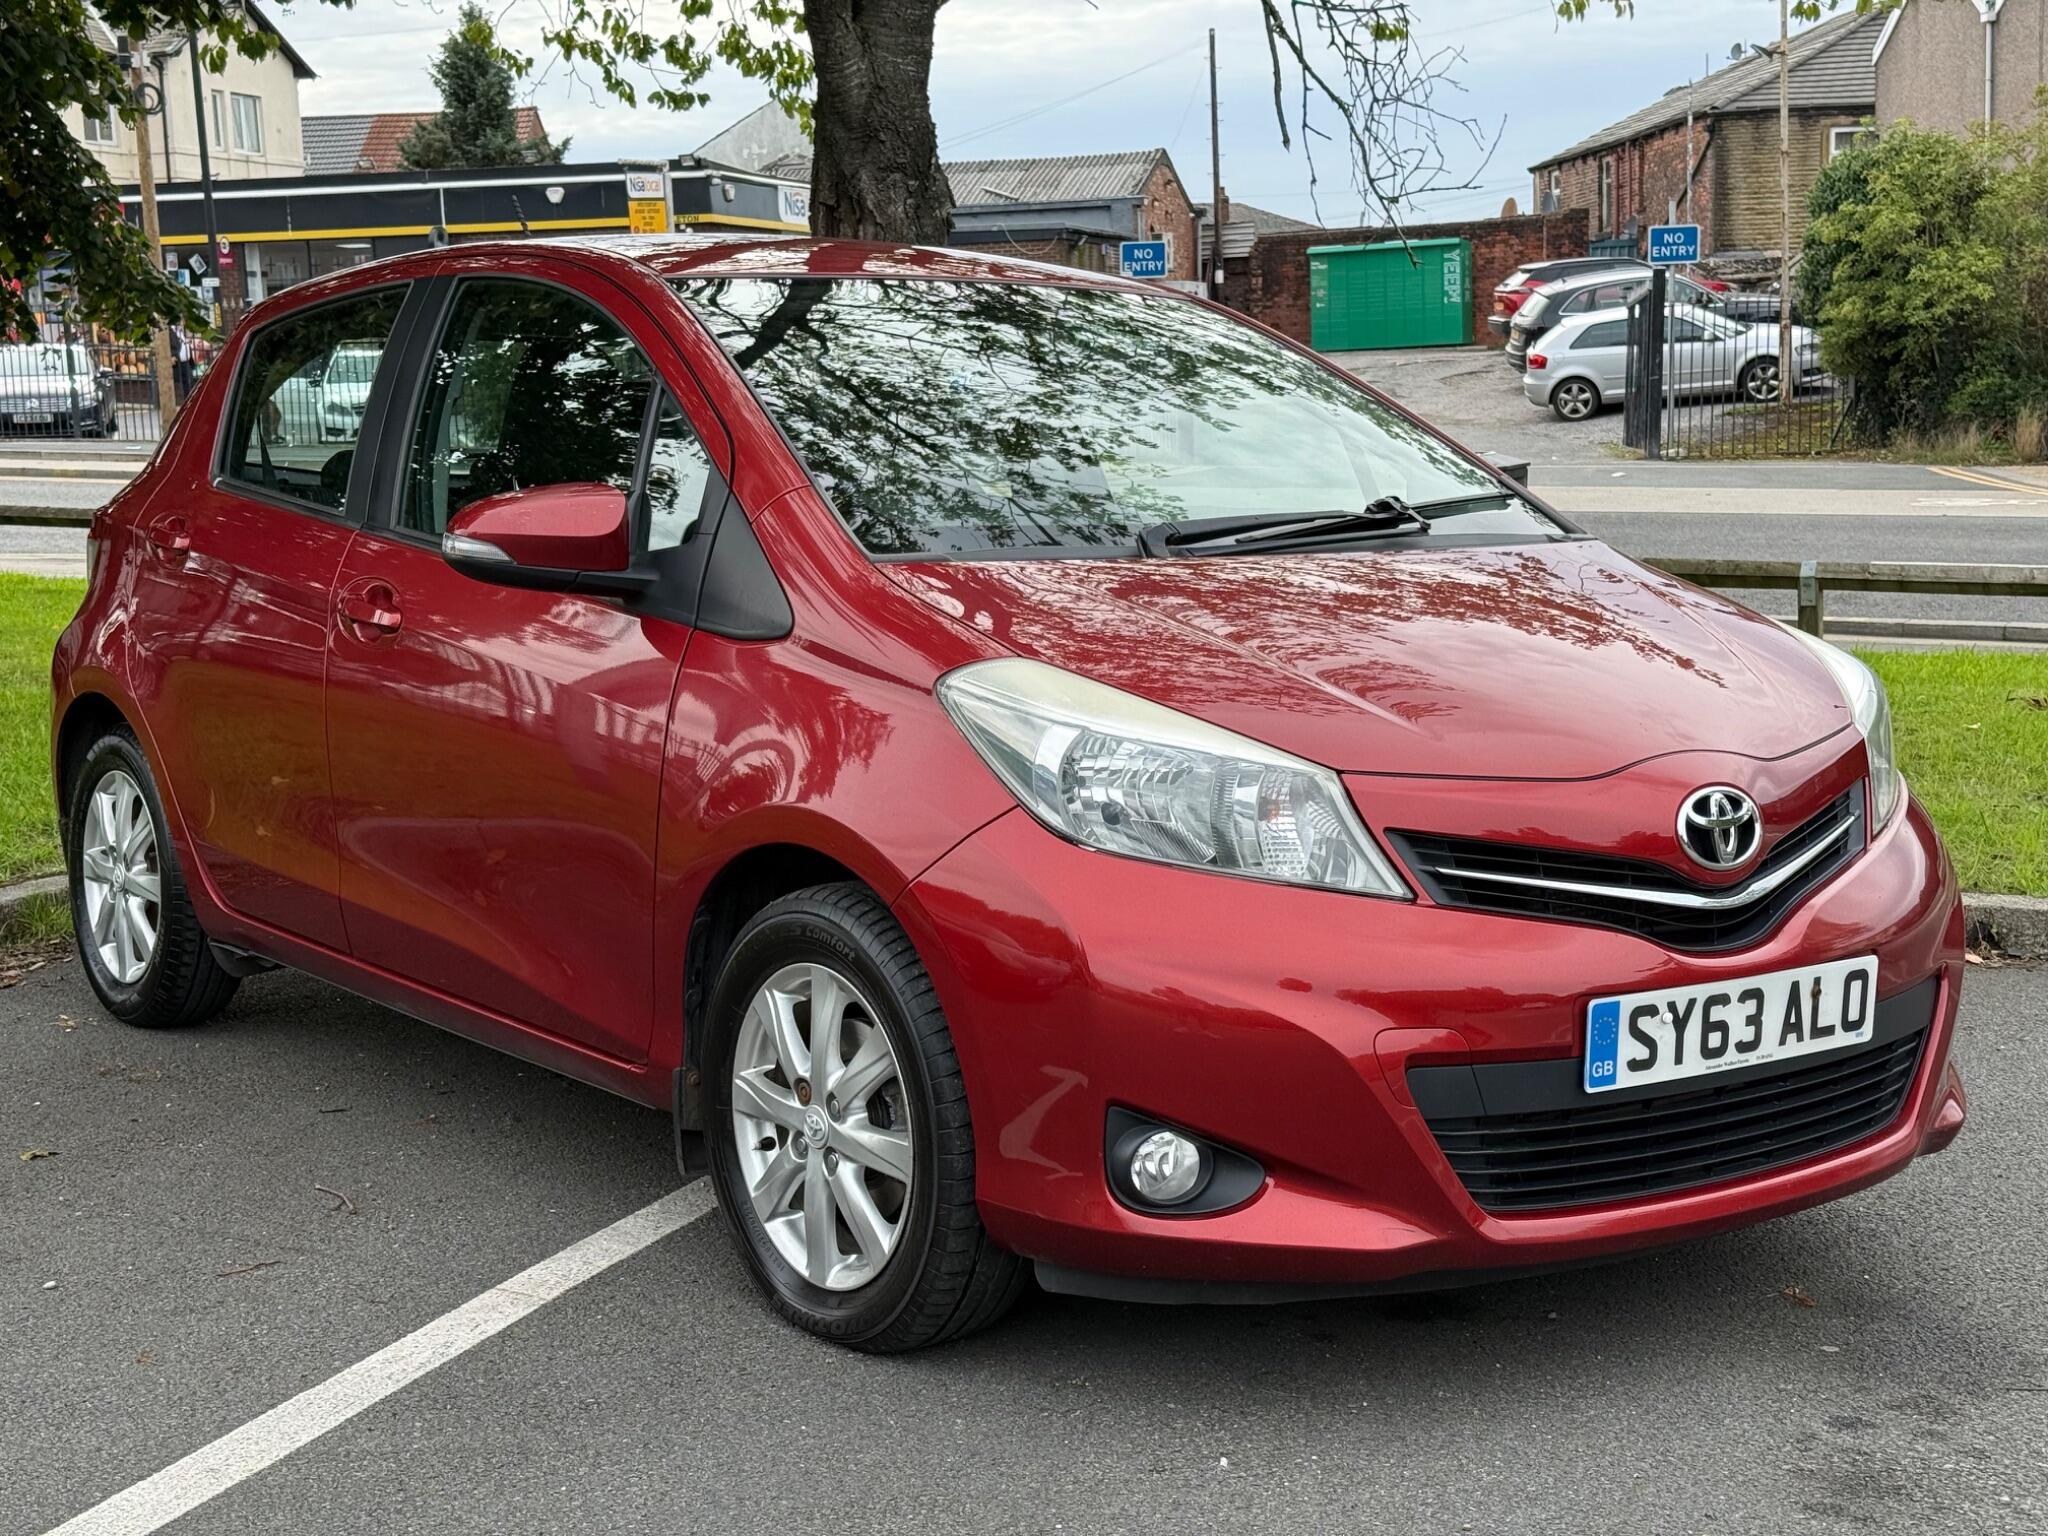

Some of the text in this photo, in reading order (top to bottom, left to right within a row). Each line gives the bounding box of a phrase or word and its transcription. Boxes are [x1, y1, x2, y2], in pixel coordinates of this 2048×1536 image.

[1663, 232, 1685, 244] NO
[1133, 248, 1153, 259] NO
[1652, 245, 1695, 257] ENTRY
[1124, 260, 1163, 271] ENTRY
[1626, 968, 1870, 1073] SY63 ALO
[1592, 1061, 1614, 1078] GB
